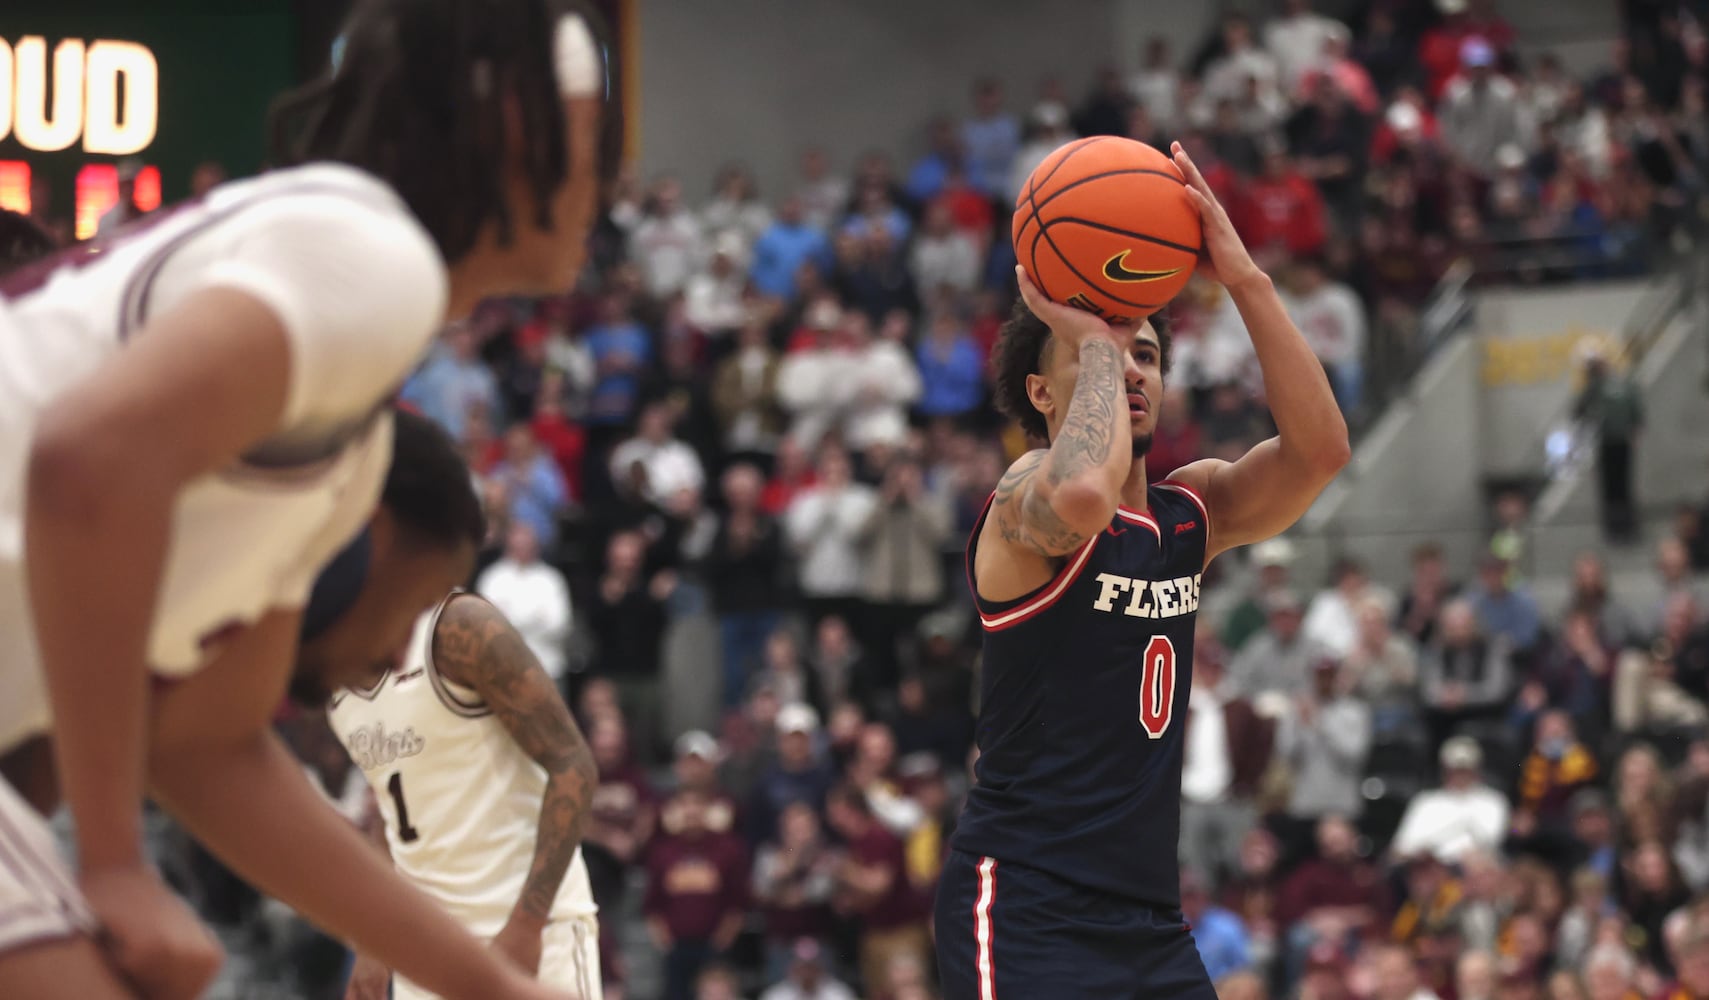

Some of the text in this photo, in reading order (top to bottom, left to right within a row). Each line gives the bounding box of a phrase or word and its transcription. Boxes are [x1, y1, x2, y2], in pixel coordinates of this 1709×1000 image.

[0, 34, 158, 155] UD
[1139, 635, 1176, 739] 0
[388, 772, 418, 842] 1
